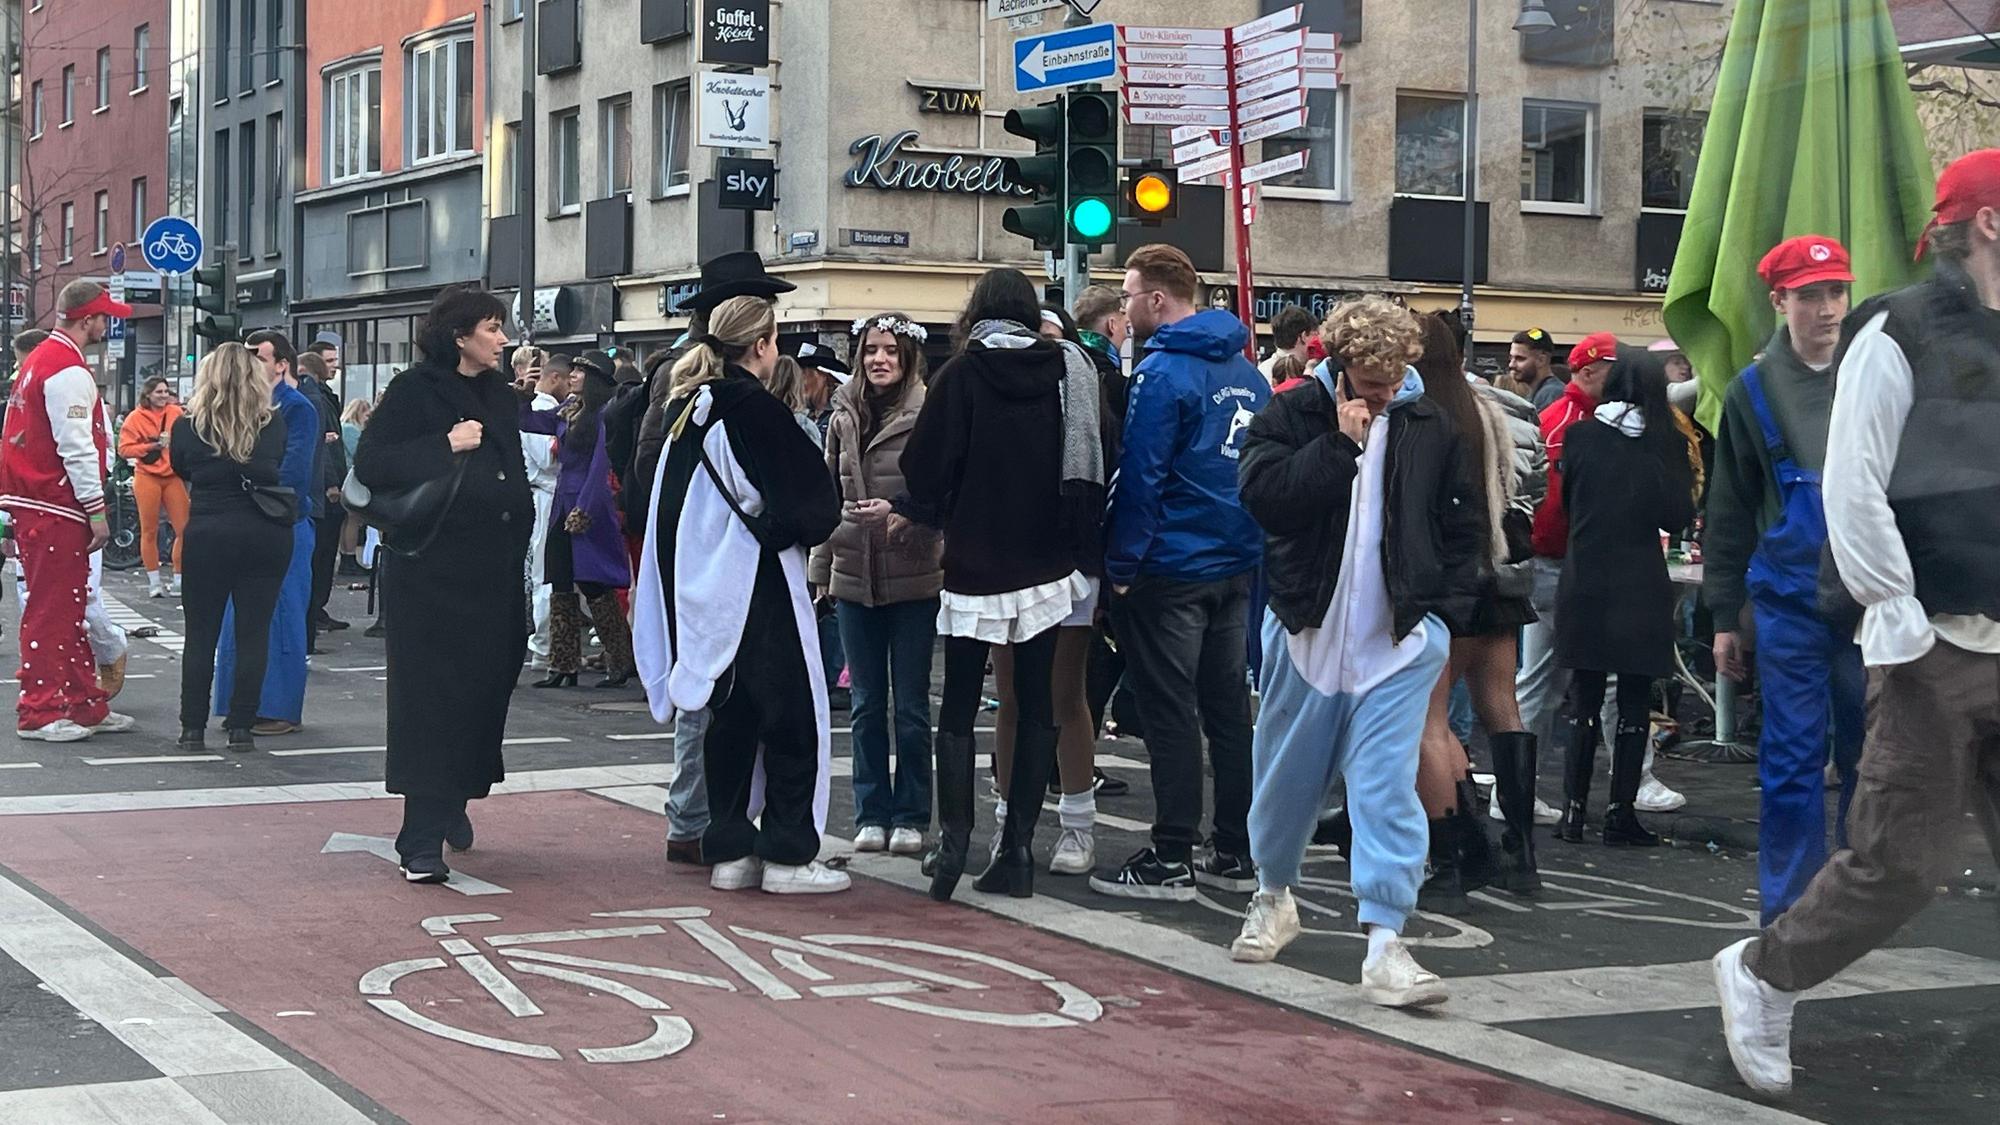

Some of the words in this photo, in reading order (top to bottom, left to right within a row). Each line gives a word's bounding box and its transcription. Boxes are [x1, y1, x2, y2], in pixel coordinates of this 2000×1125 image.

[716, 8, 756, 27] Gaffel
[1140, 31, 1192, 40] Uni-Kliniken
[1043, 46, 1110, 67] Einbahnstraße
[1140, 51, 1188, 60] Universität
[1142, 70, 1183, 82] Zülpicher
[1185, 71, 1206, 81] Platz
[923, 90, 982, 112] ZUM
[1143, 91, 1186, 103] Synagoge
[1144, 111, 1207, 122] Rathenauplatz
[726, 169, 768, 198] sky
[855, 231, 892, 243] Brüsseler
[893, 233, 906, 244] Str.
